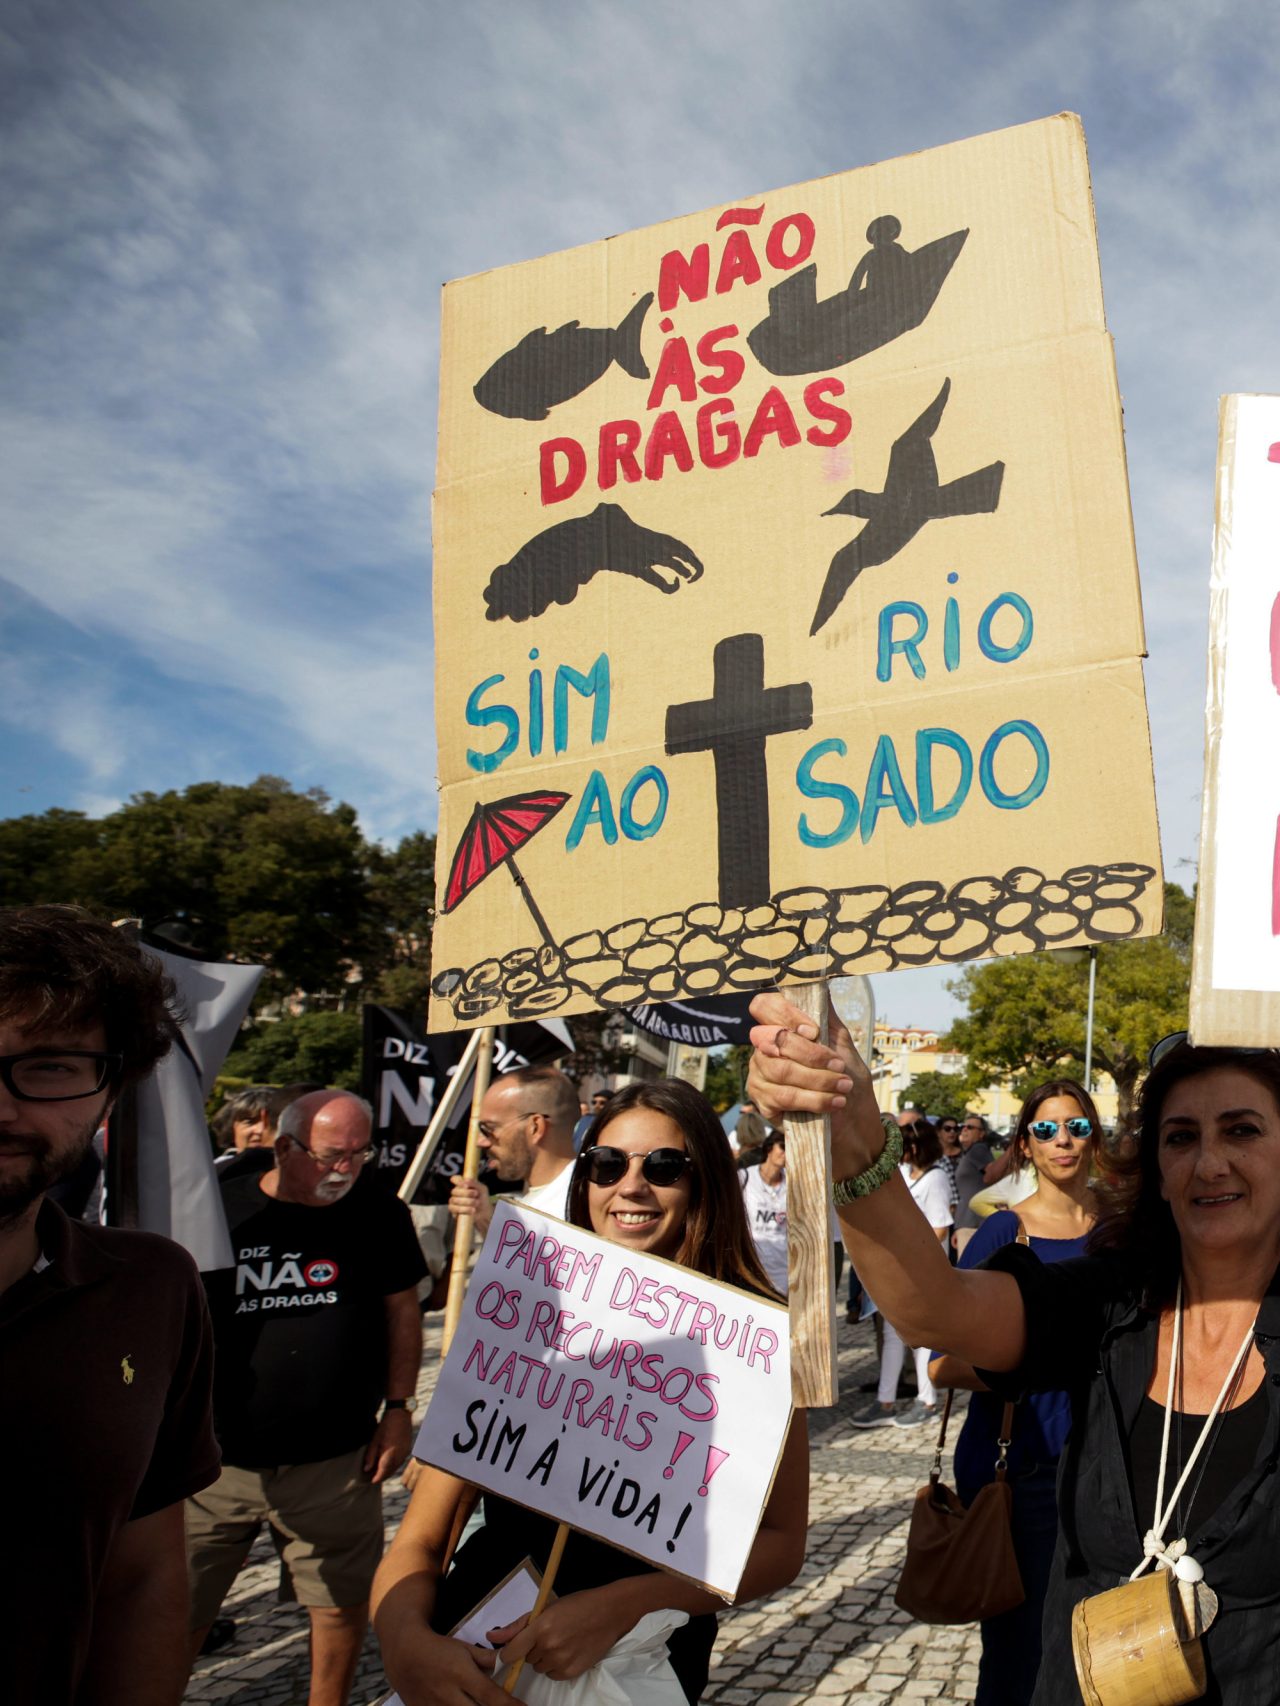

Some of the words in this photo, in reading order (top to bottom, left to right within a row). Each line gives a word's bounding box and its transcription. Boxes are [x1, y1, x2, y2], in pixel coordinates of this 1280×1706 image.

[657, 203, 815, 311] NÃO
[647, 317, 745, 410] ÀS
[539, 377, 852, 506] DRAGAS
[876, 572, 1034, 682] RIO
[465, 647, 610, 773] SIM
[565, 765, 669, 852] AO
[796, 718, 1050, 849] SADO
[384, 1037, 430, 1065] DIZ
[239, 1246, 270, 1260] DIZ
[261, 1291, 338, 1309] DRAGAS
[493, 1219, 603, 1302] PAREM
[609, 1267, 779, 1374] DESTRUIR
[475, 1281, 522, 1330] OS
[525, 1301, 720, 1422] RECURSOS
[453, 1398, 527, 1473] SIM
